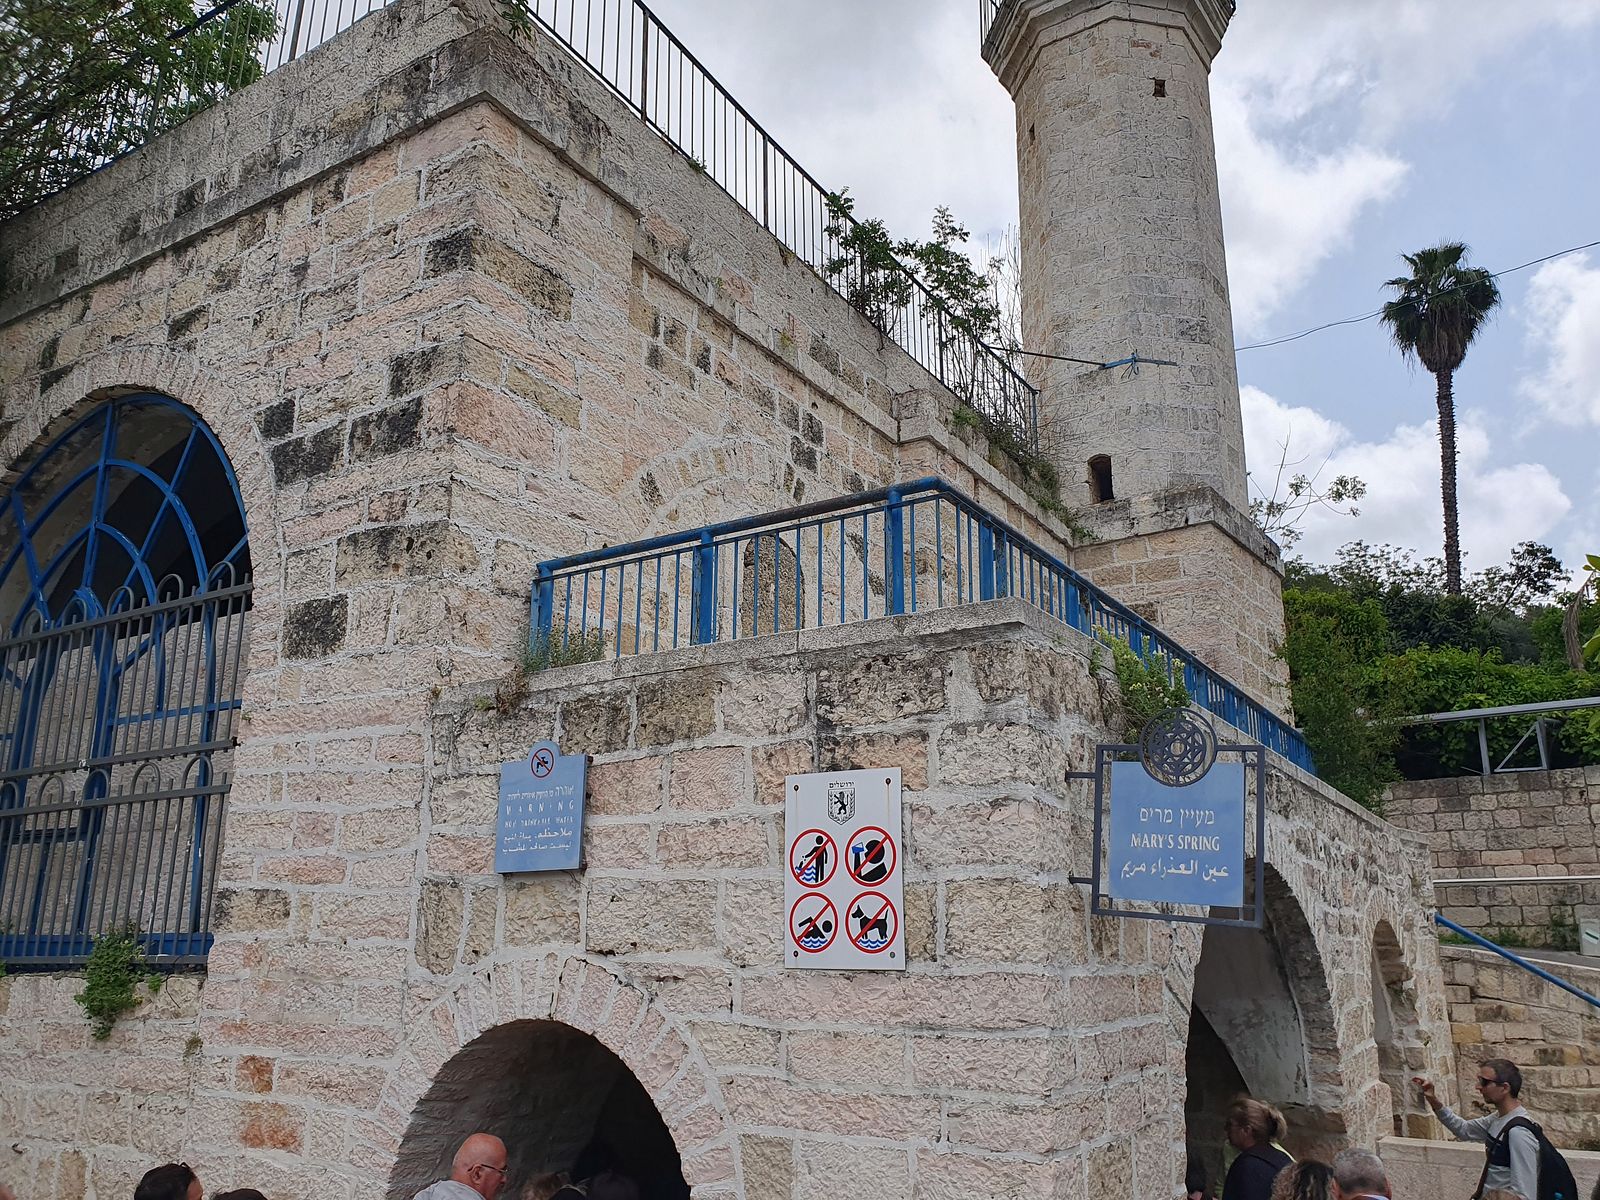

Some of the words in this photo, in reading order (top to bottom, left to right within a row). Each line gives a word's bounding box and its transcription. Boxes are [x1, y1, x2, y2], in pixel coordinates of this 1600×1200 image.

[829, 780, 855, 788] ירושלים
[1139, 807, 1173, 824] מרים
[1179, 808, 1215, 828] מעיין
[1130, 833, 1174, 849] MARY'S
[1177, 834, 1220, 851] SPRING
[1121, 859, 1147, 880] مريم
[1151, 857, 1198, 880] العذراء
[1202, 864, 1229, 882] عين
